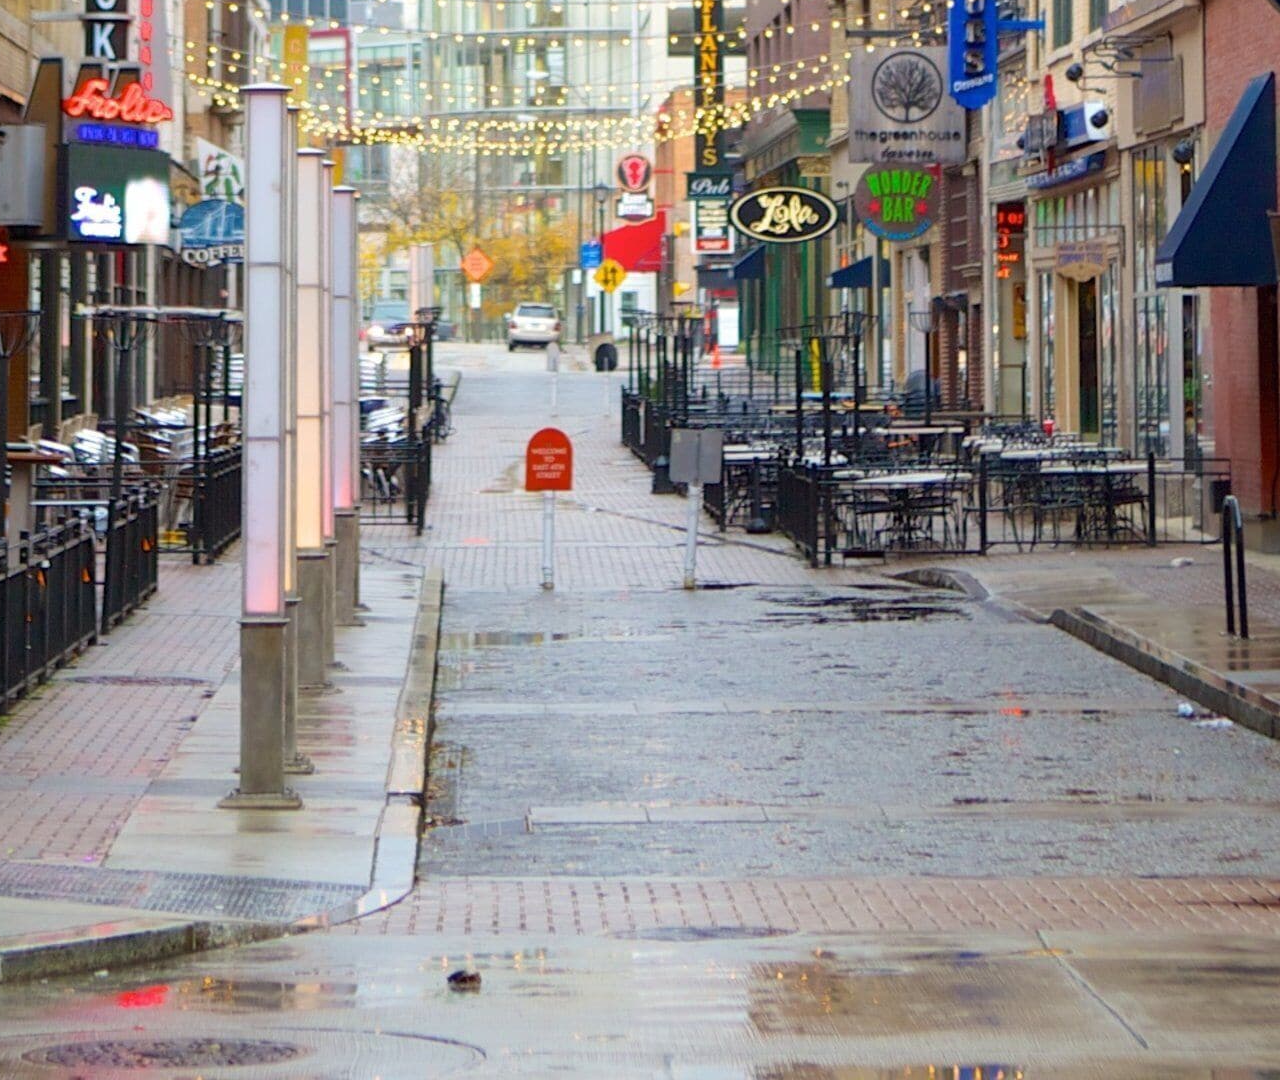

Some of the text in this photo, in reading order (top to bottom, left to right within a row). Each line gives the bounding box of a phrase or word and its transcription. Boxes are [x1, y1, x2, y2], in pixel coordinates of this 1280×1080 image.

[689, 177, 731, 196] Pub
[865, 170, 933, 198] WONDER
[750, 193, 820, 235] Lola
[882, 196, 915, 223] BAR
